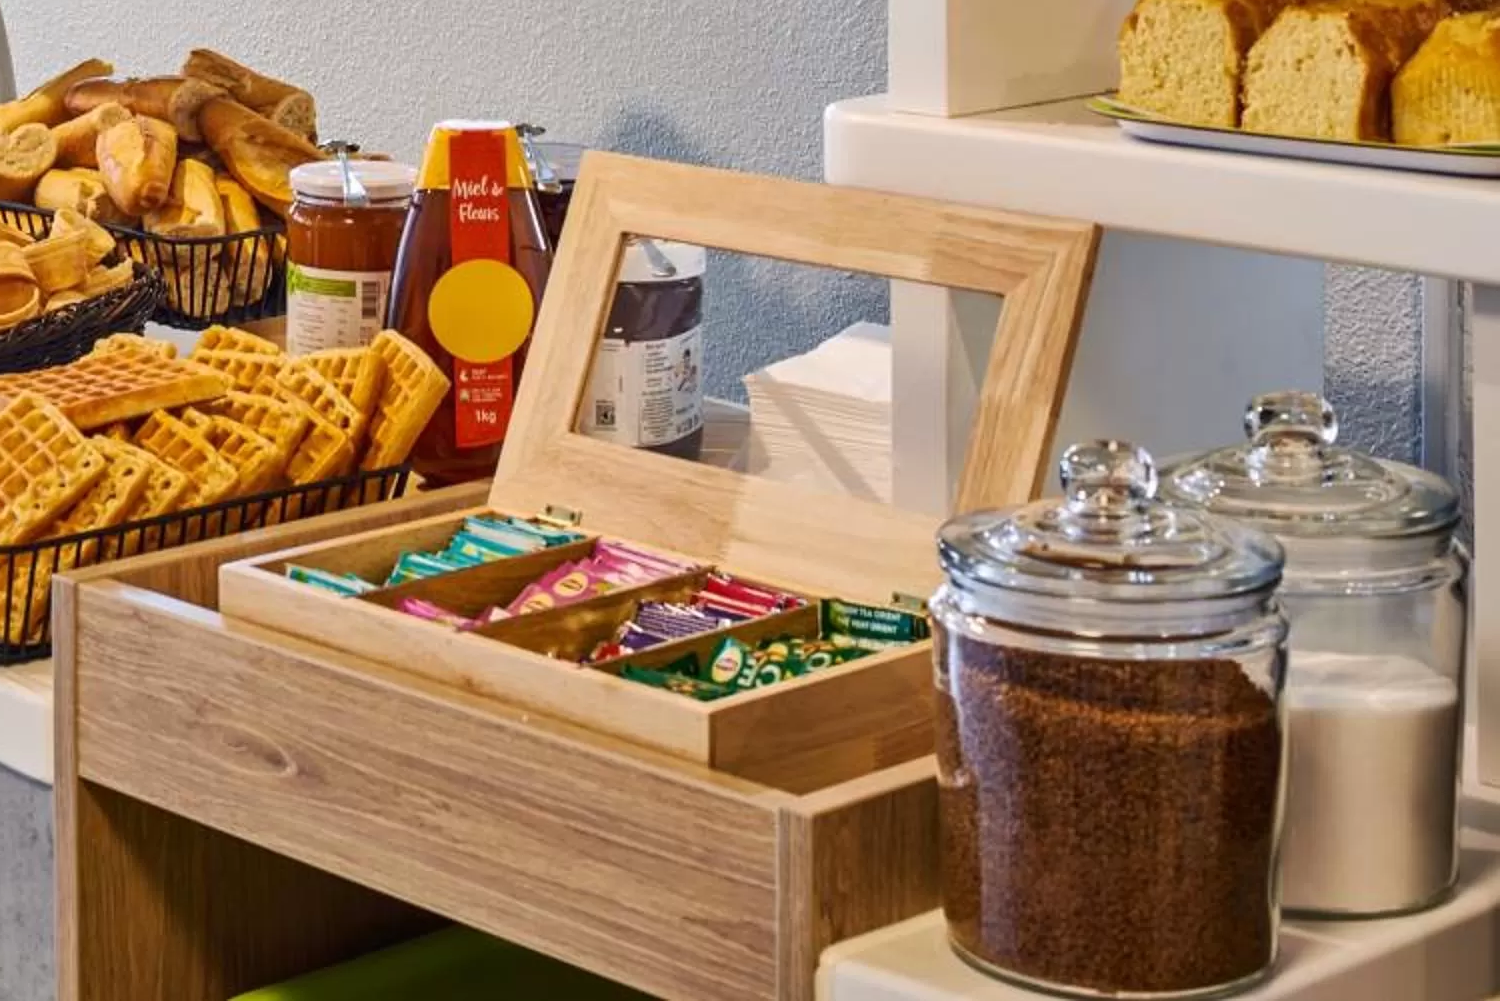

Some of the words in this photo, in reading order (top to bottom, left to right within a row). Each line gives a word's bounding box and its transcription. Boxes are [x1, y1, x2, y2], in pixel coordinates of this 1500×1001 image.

[451, 173, 489, 200] Miel
[459, 201, 500, 224] Fleurs
[475, 408, 497, 425] 1kg
